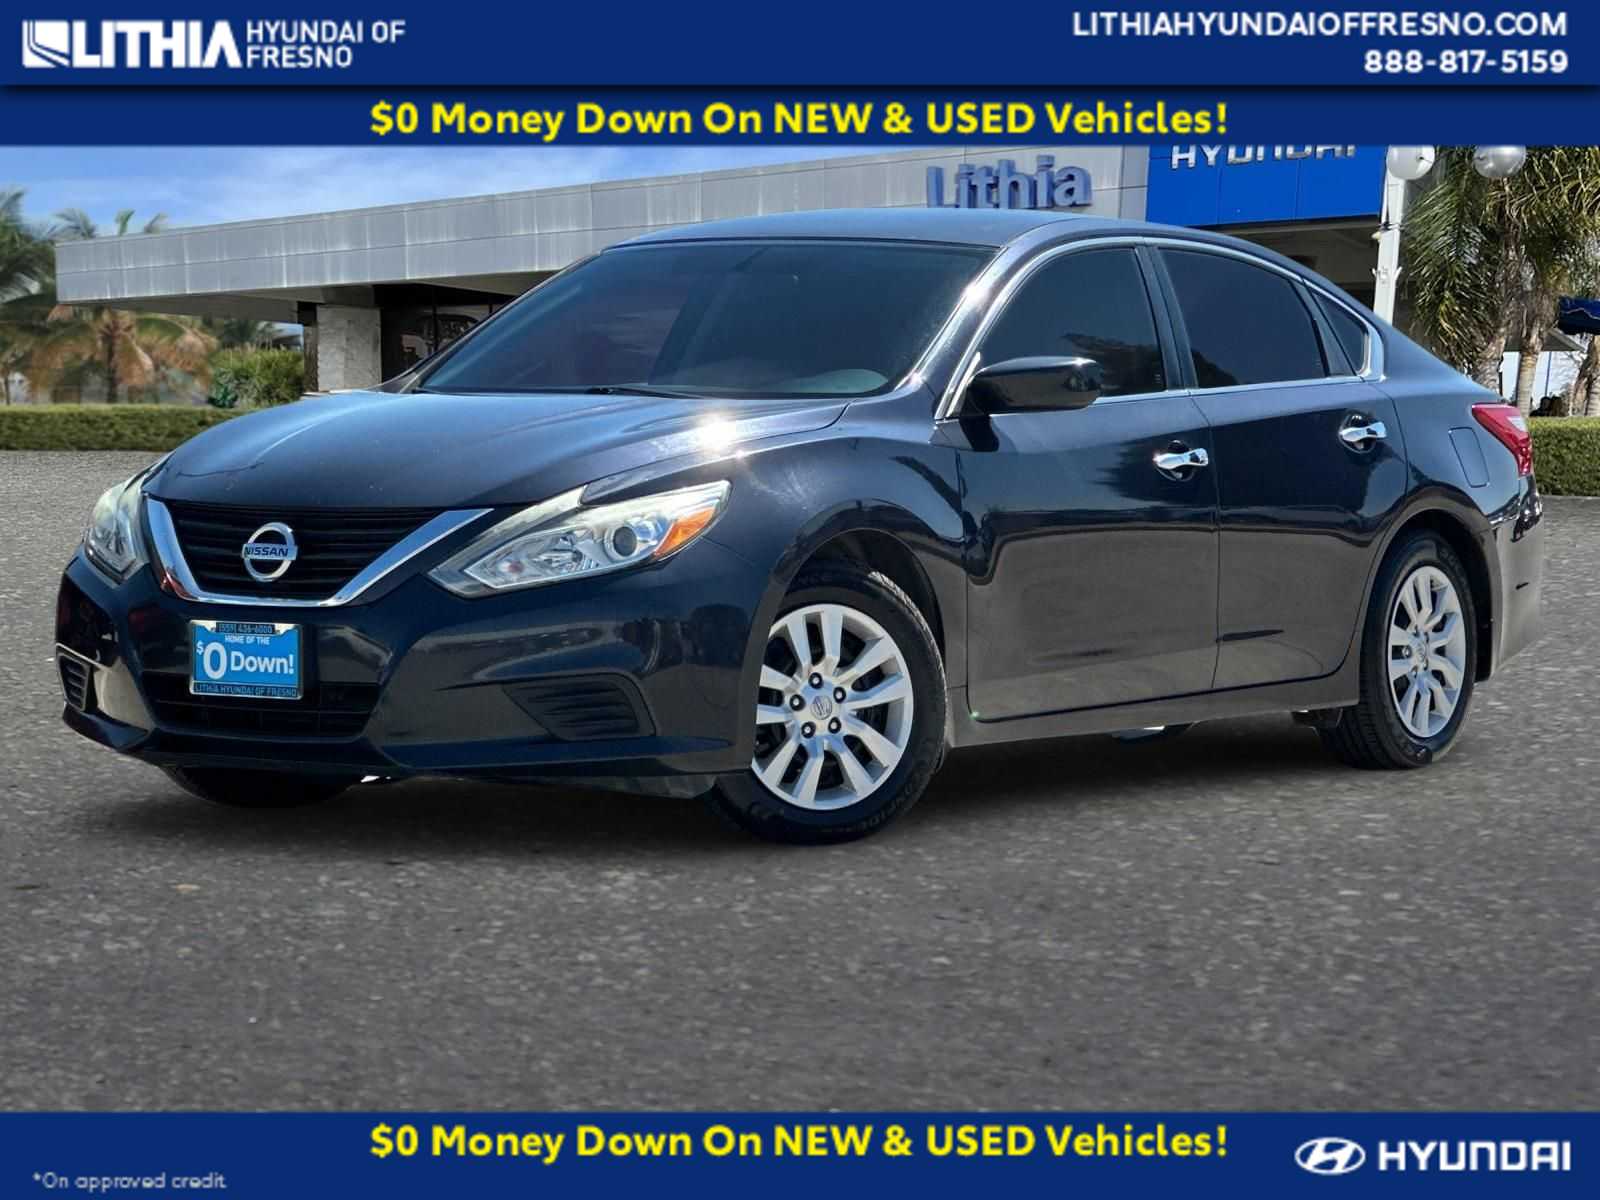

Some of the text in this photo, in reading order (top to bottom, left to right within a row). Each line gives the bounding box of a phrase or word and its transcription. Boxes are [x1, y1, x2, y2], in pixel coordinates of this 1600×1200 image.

[926, 154, 1092, 209] Lithia
[245, 546, 289, 557] NISSAN
[224, 634, 271, 646] HOME OF THE
[230, 651, 295, 675] Down!
